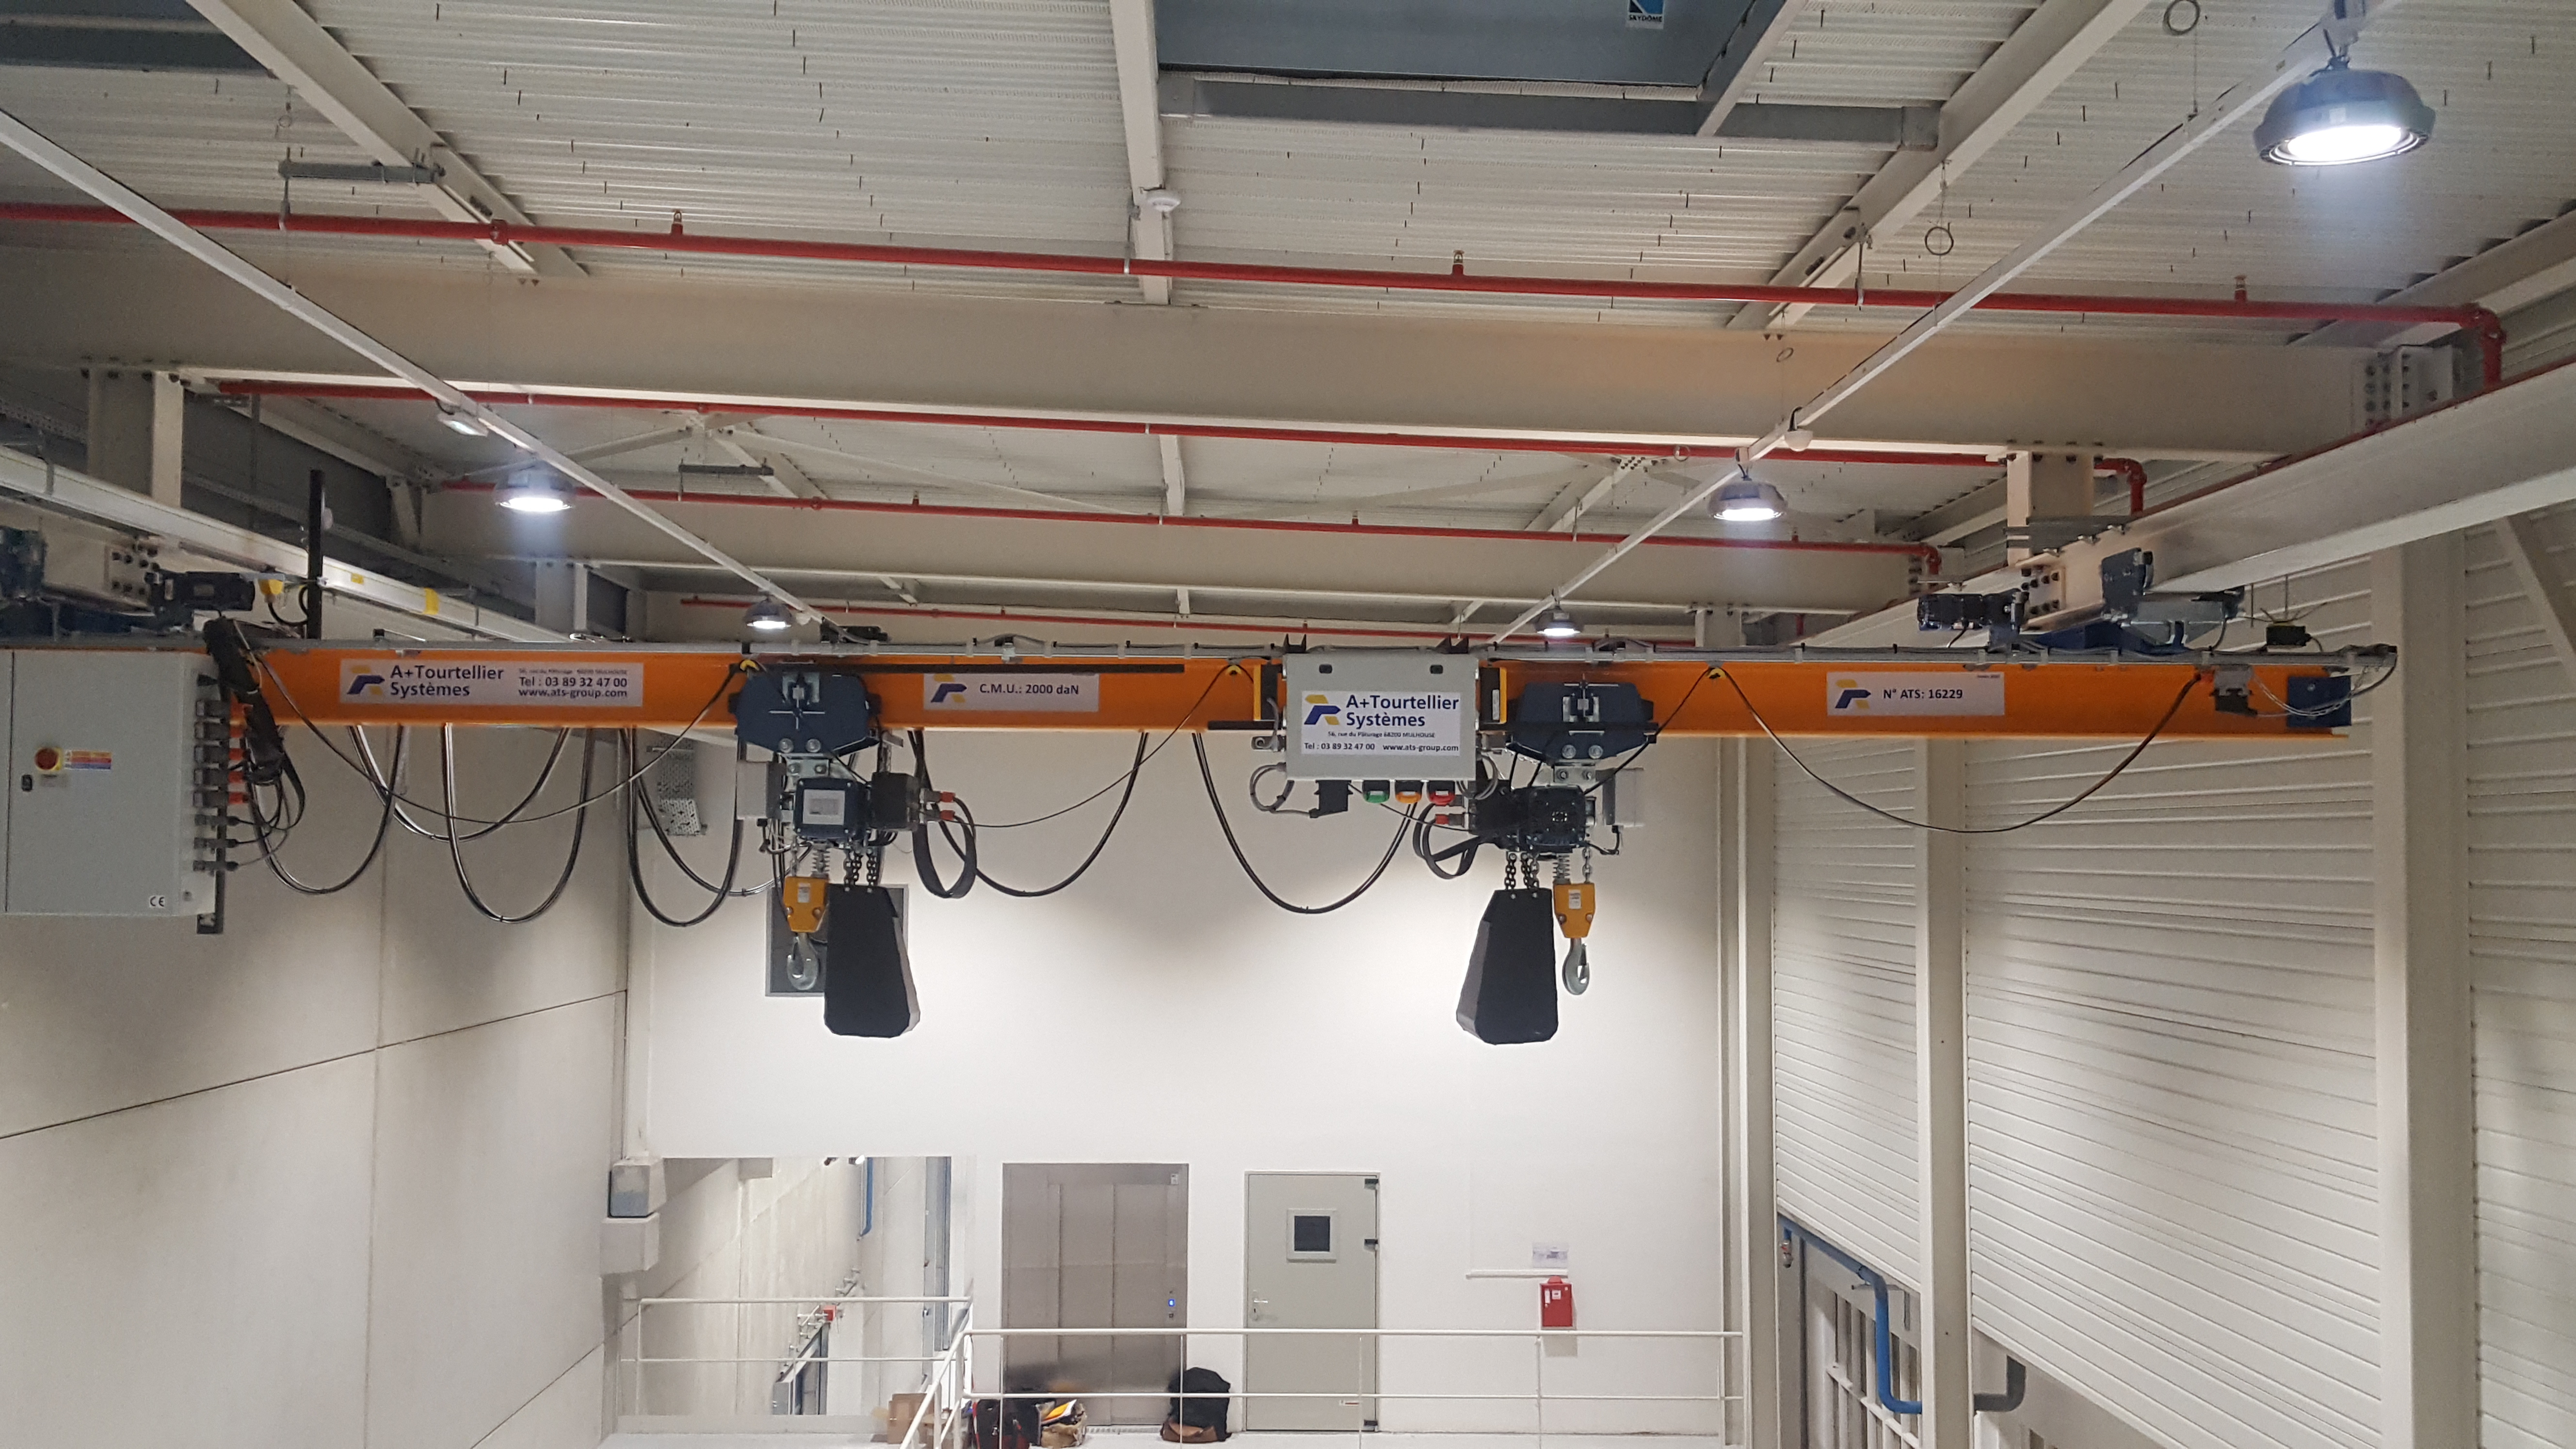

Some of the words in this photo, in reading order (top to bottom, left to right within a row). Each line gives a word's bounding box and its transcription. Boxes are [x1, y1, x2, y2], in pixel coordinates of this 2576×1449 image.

[390, 664, 504, 679] A+Tourtellier
[519, 676, 534, 686] Tel
[545, 677, 559, 687] 03
[563, 677, 576, 687] 89
[579, 677, 593, 687] 32
[596, 677, 610, 687] 47
[613, 677, 628, 687] 00
[390, 681, 470, 699] Systèmes
[519, 689, 628, 699] www.ats-group.com
[1026, 684, 1053, 694] 2000
[1056, 684, 1079, 694] daN
[1900, 689, 1924, 699] ATS:
[1928, 689, 1963, 699] 16229
[1346, 694, 1459, 710] A+Tourtellier
[1346, 711, 1426, 729] Systèmes
[150, 896, 164, 907] CE
